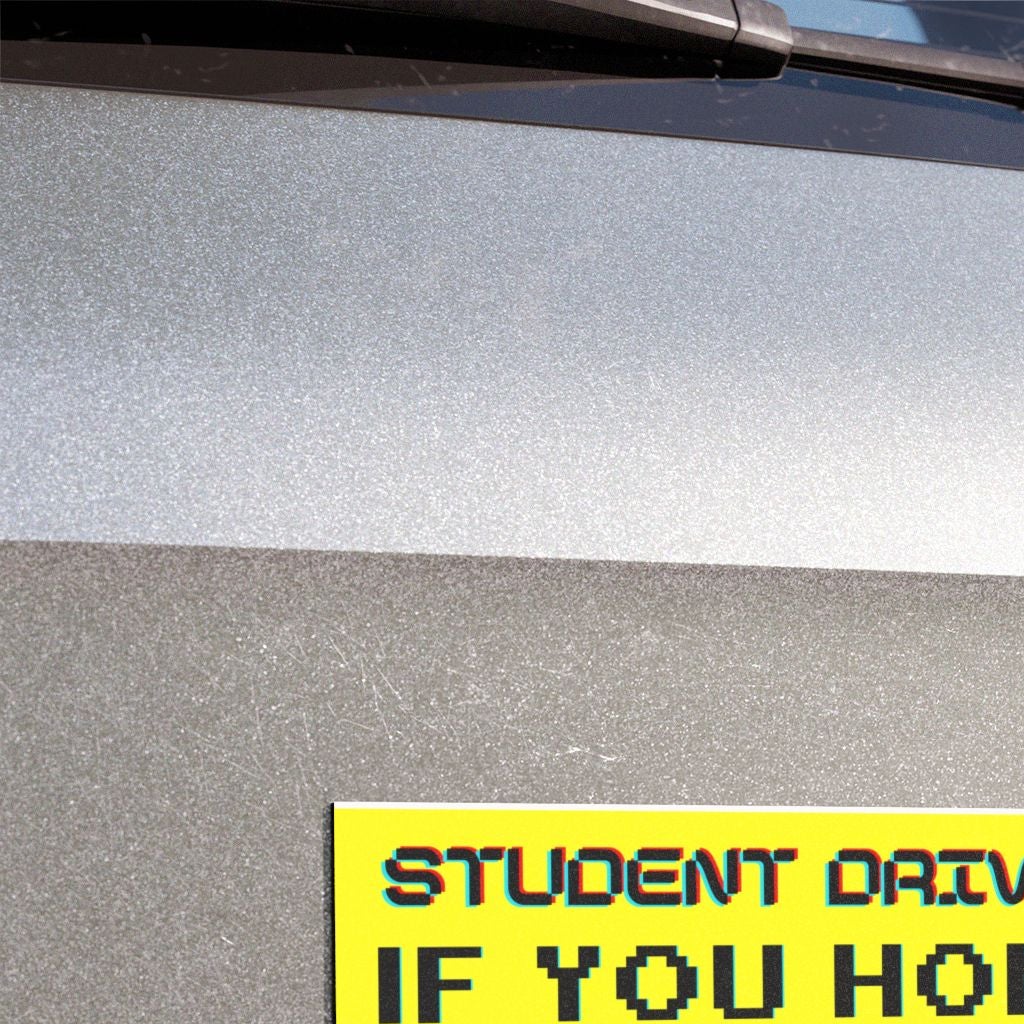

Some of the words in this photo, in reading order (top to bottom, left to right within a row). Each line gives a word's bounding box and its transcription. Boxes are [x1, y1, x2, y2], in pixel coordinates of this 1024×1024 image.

[381, 846, 798, 907] STUDENT
[378, 946, 483, 1024] IF
[537, 945, 784, 1021] YOU
